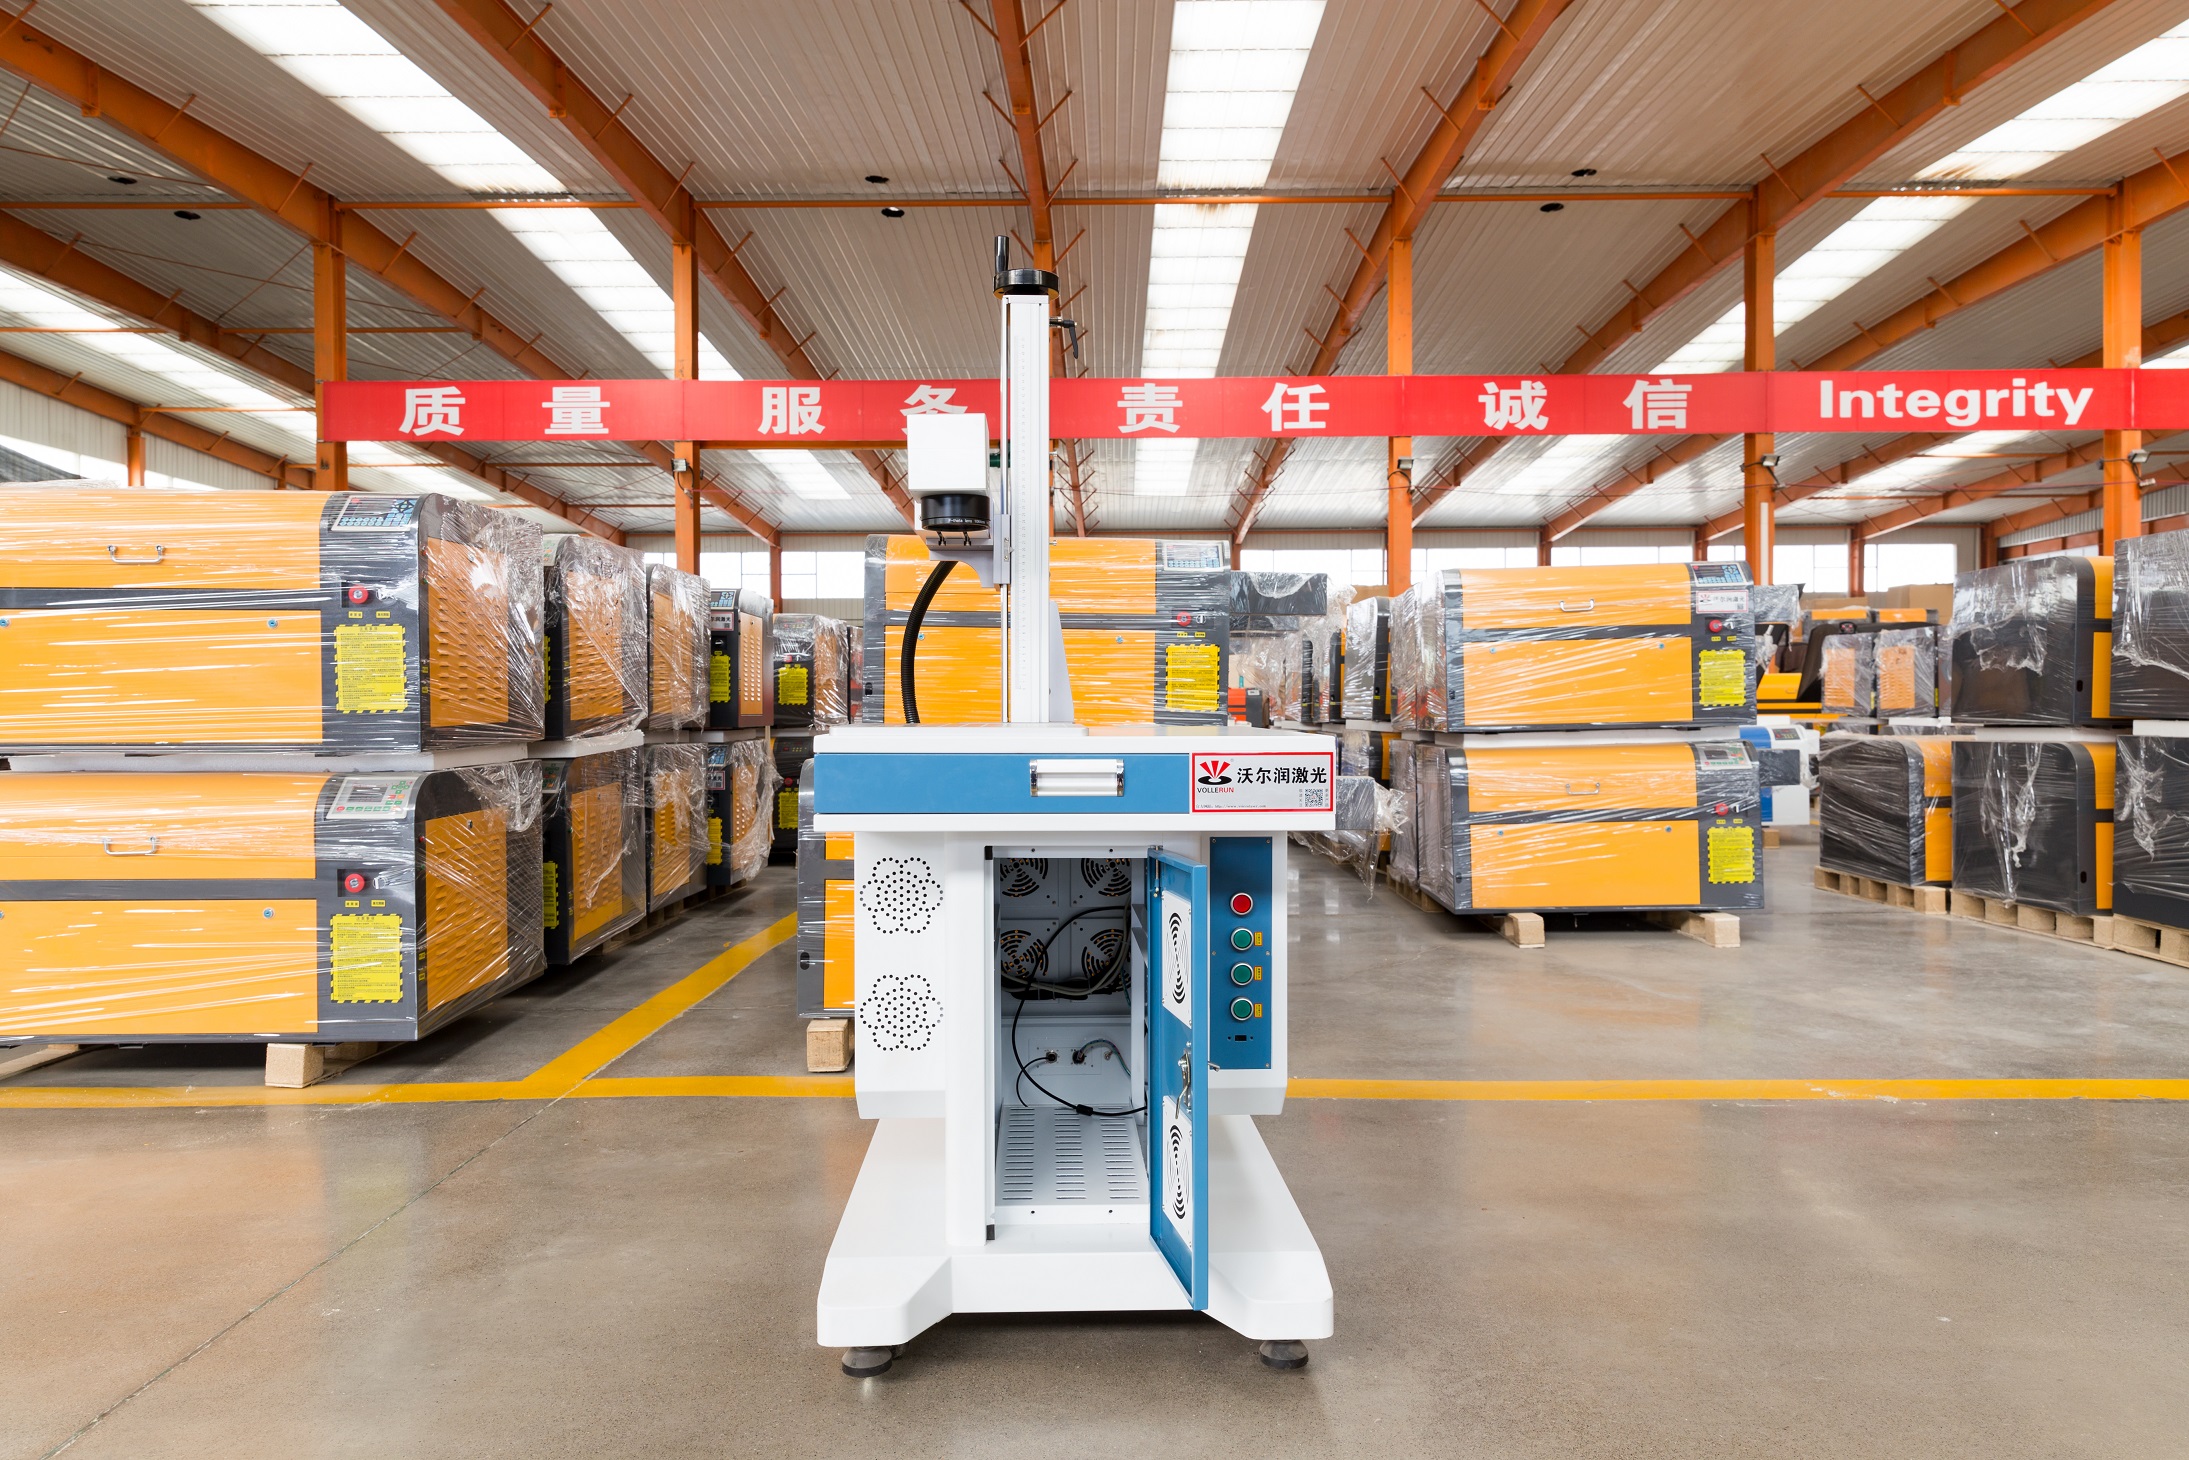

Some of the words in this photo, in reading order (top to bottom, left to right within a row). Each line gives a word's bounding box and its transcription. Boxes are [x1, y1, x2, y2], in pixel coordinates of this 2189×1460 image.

[399, 386, 610, 436] 质量
[1117, 382, 1329, 433] 责任
[1479, 379, 1692, 430] 诚信
[1820, 378, 2094, 426] Integrity
[1237, 767, 1327, 784] 沃尔润激光
